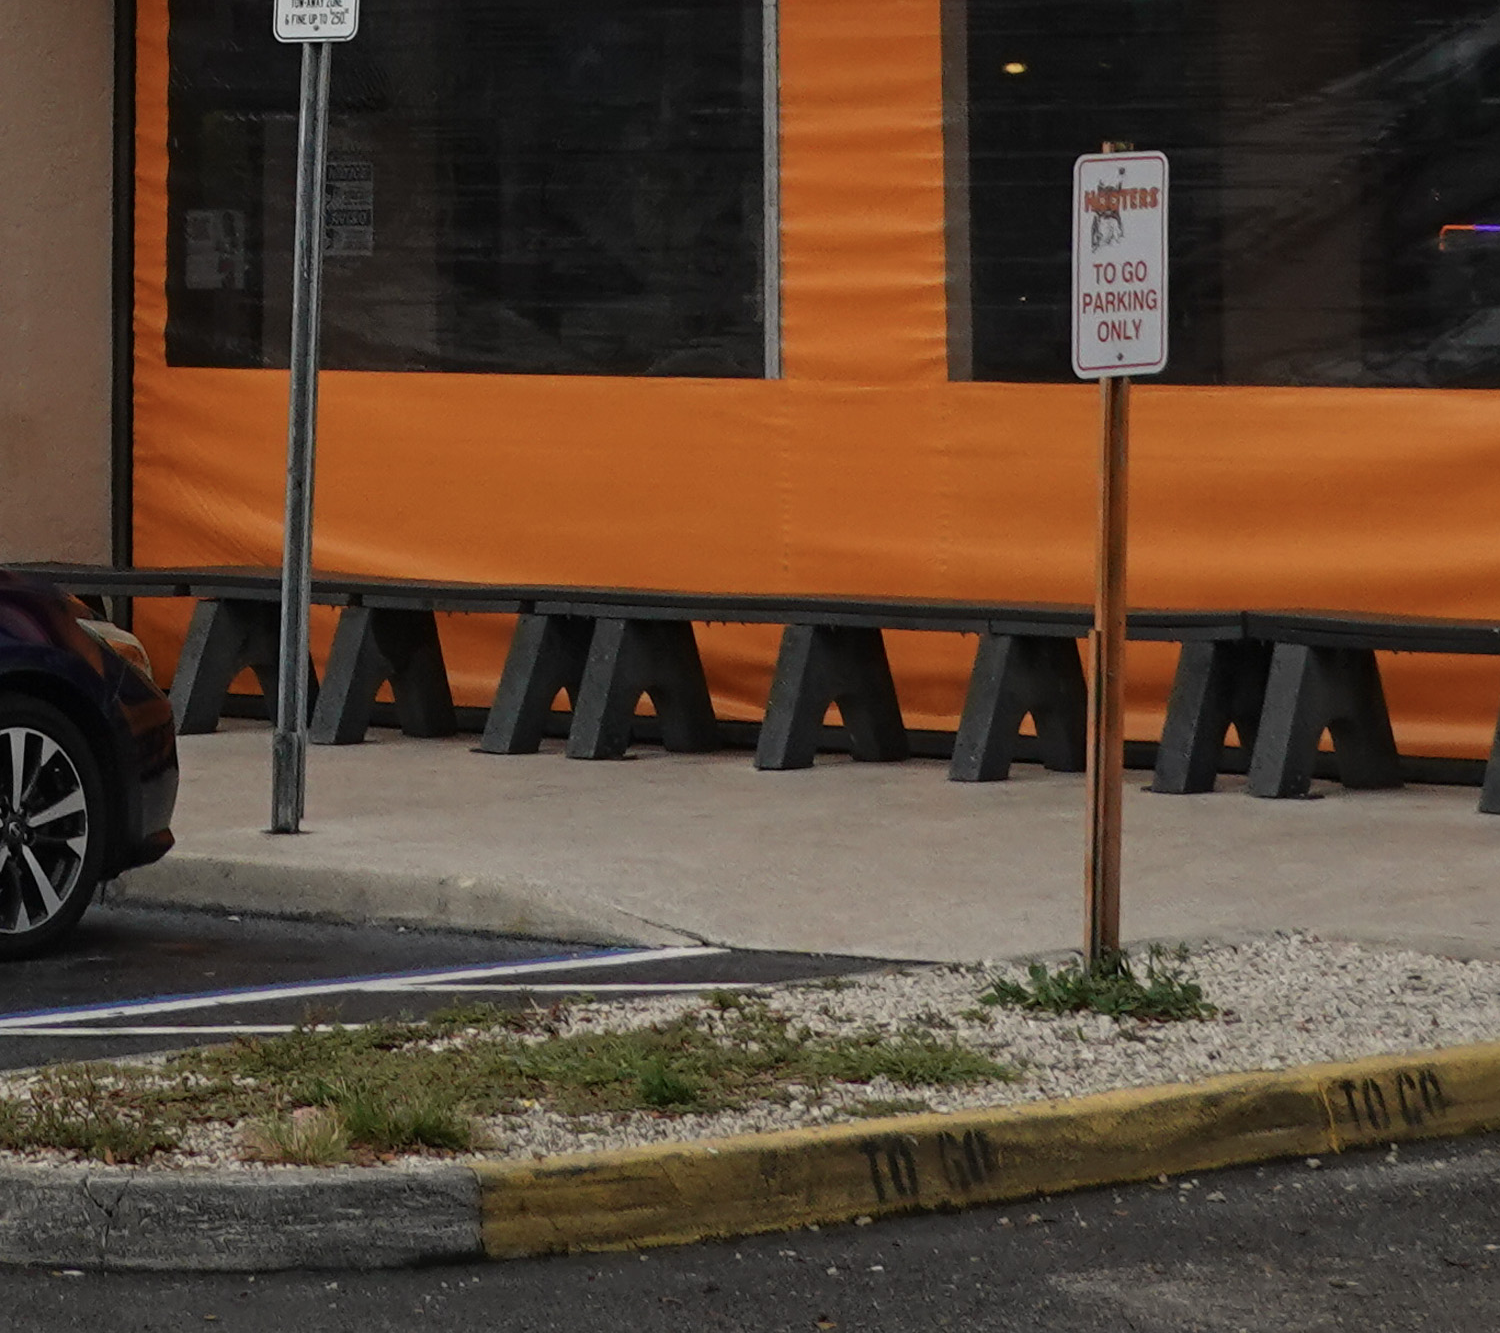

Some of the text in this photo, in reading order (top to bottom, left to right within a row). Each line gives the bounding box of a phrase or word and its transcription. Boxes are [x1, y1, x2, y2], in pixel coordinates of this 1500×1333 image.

[291, 14, 307, 25] FINE
[308, 14, 318, 25] UP
[319, 13, 328, 25] TO
[1084, 187, 1160, 213] HOOTERS
[1093, 260, 1148, 285] TO GO
[1083, 289, 1158, 315] PARKING
[1097, 319, 1142, 342] ONLY
[1332, 1077, 1391, 1130] TO
[860, 1136, 918, 1203] TO
